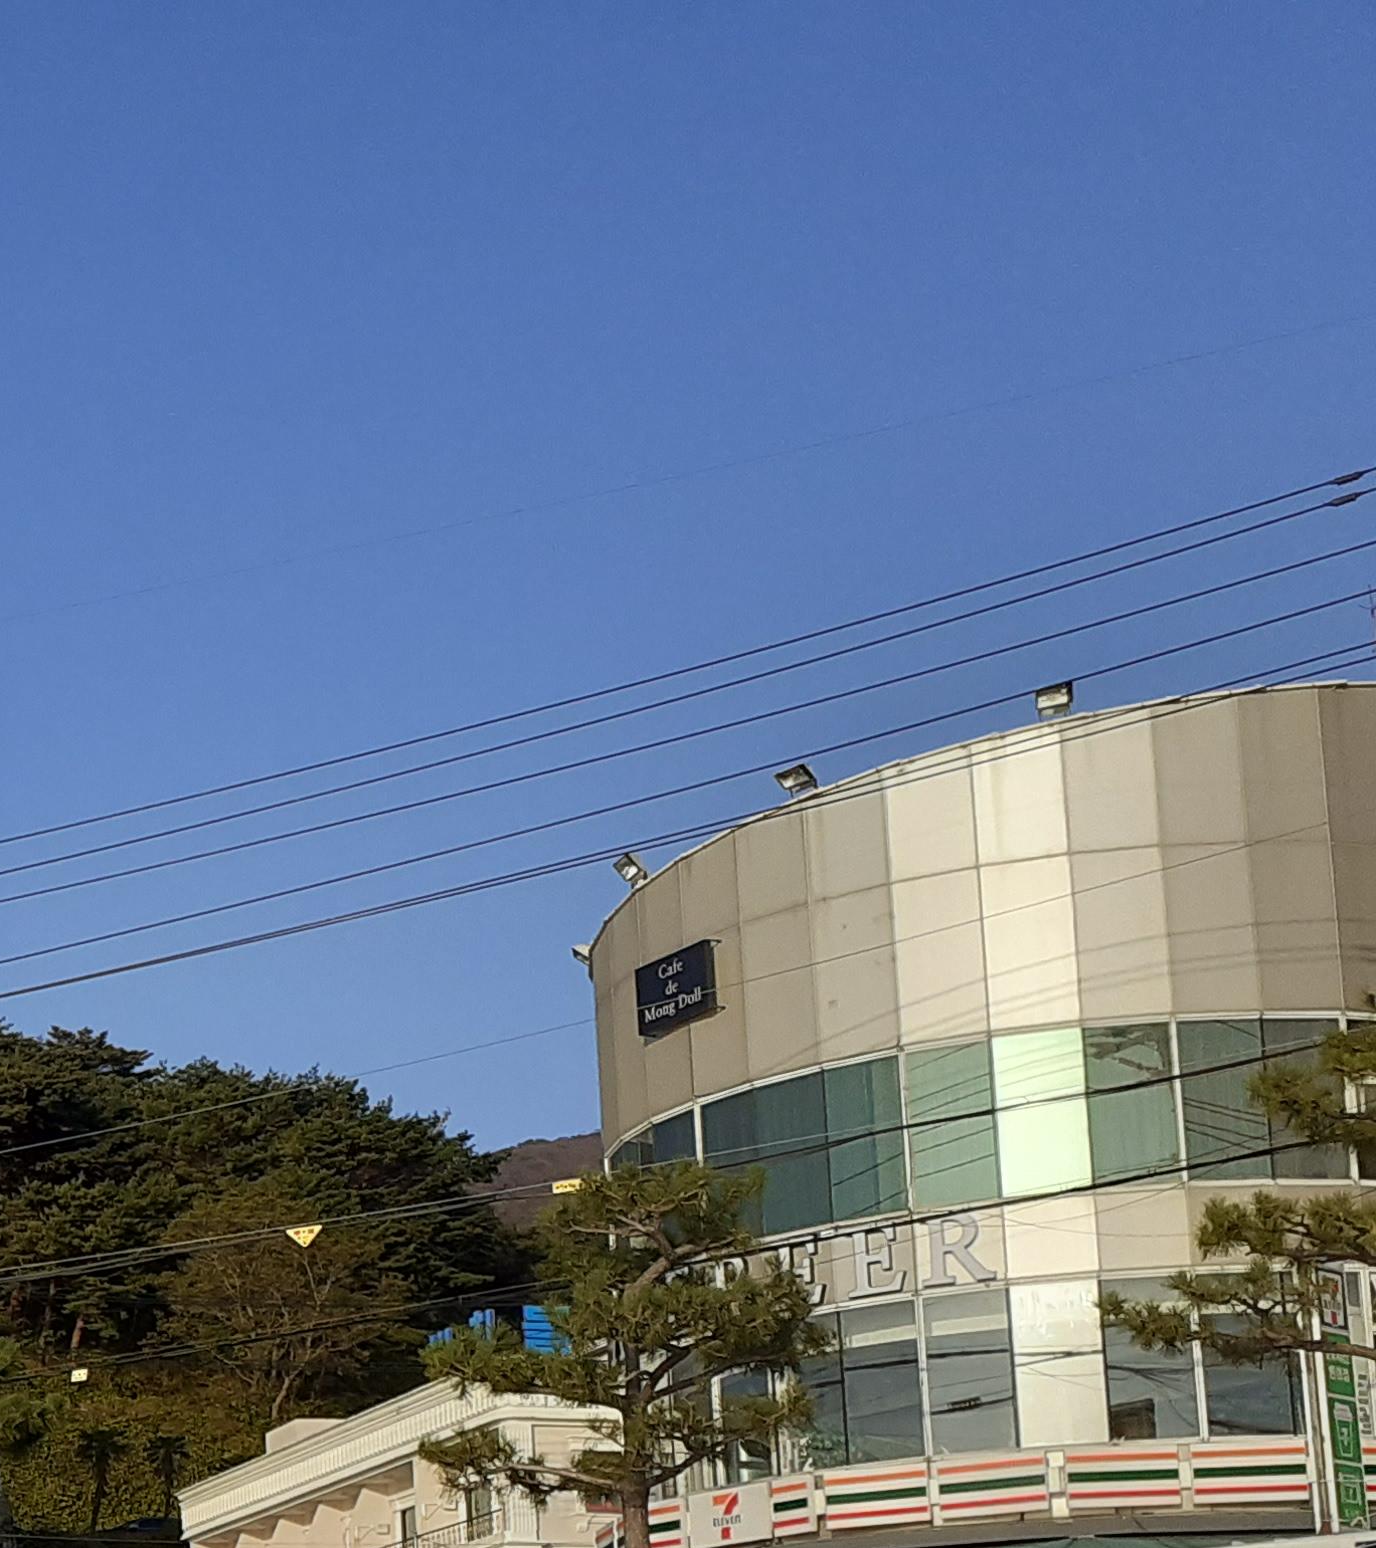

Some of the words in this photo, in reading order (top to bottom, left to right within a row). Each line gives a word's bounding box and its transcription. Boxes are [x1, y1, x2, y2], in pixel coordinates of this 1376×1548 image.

[658, 958, 683, 979] Cafe
[665, 980, 679, 995] de
[644, 1002, 676, 1023] Mong
[678, 986, 702, 1009] Doll
